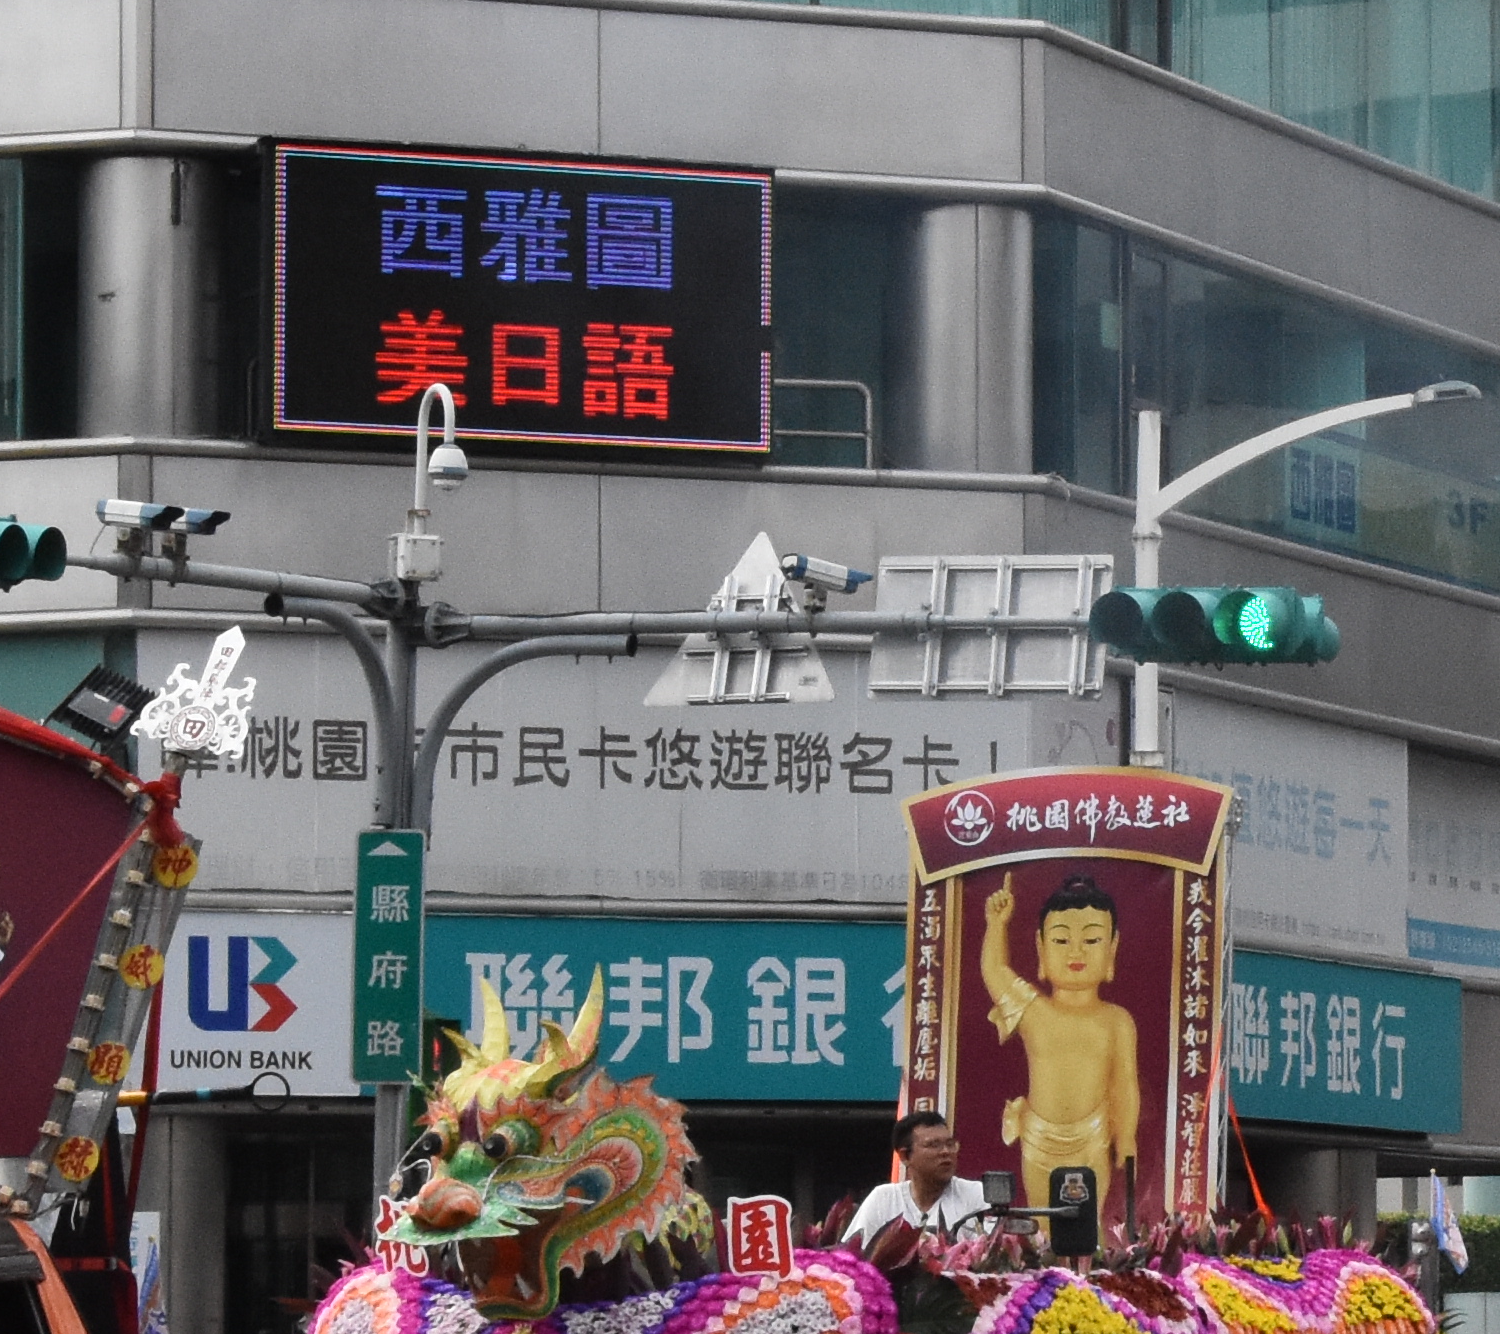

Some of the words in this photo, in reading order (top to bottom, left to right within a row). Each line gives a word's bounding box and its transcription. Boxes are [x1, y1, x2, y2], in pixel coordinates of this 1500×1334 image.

[375, 184, 673, 292] 西雅圖
[375, 310, 674, 421] 美日語
[1006, 792, 1191, 845] 桃園佛教蓮社
[368, 882, 411, 1058] 縣府路
[464, 953, 906, 1067] 聯邦銀
[169, 1048, 244, 1073] UNION
[250, 1048, 313, 1073] BANK
[1229, 981, 1407, 1103] 聯邦銀行
